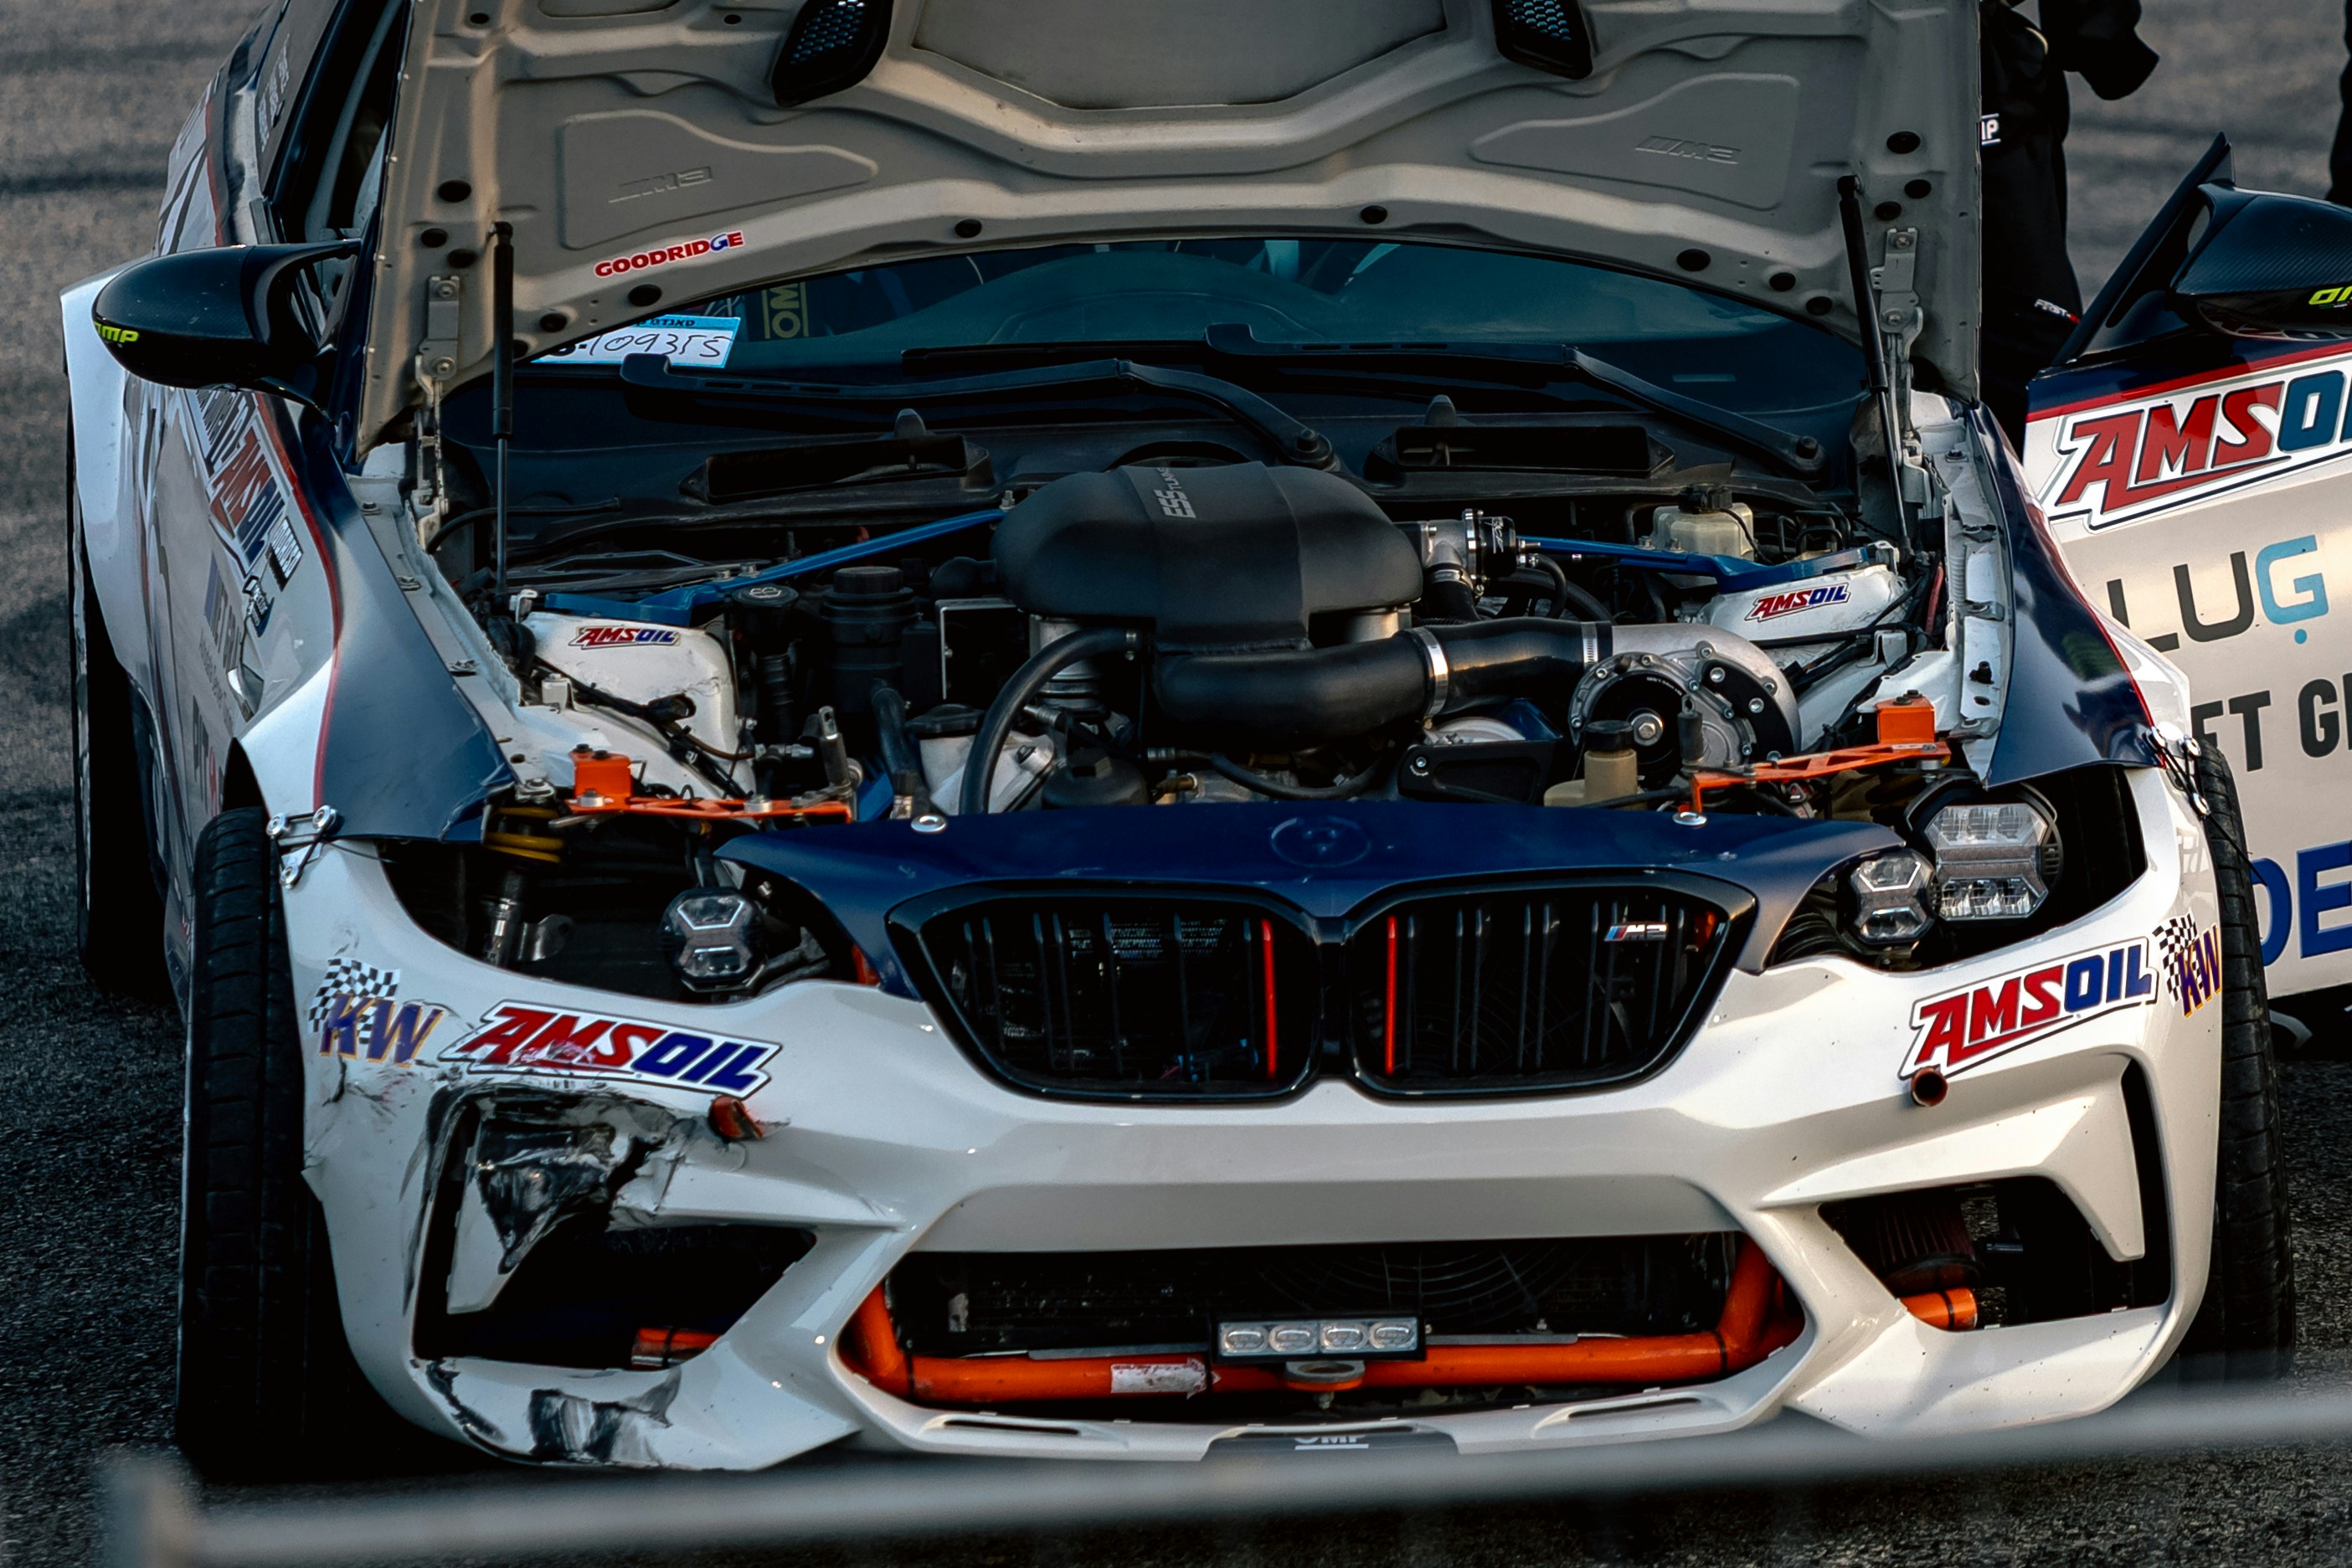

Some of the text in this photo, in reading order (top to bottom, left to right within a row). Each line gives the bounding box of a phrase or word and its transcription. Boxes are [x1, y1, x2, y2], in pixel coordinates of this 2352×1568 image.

[594, 232, 744, 277] GOODRIDGE
[576, 627, 677, 645] AMSOIL
[1751, 586, 1848, 619] AMSOIL
[1914, 943, 2152, 1067] AMSOIL
[2177, 925, 2221, 1018] KW
[319, 992, 445, 1068] KW
[455, 1006, 766, 1091] AMSOIL
